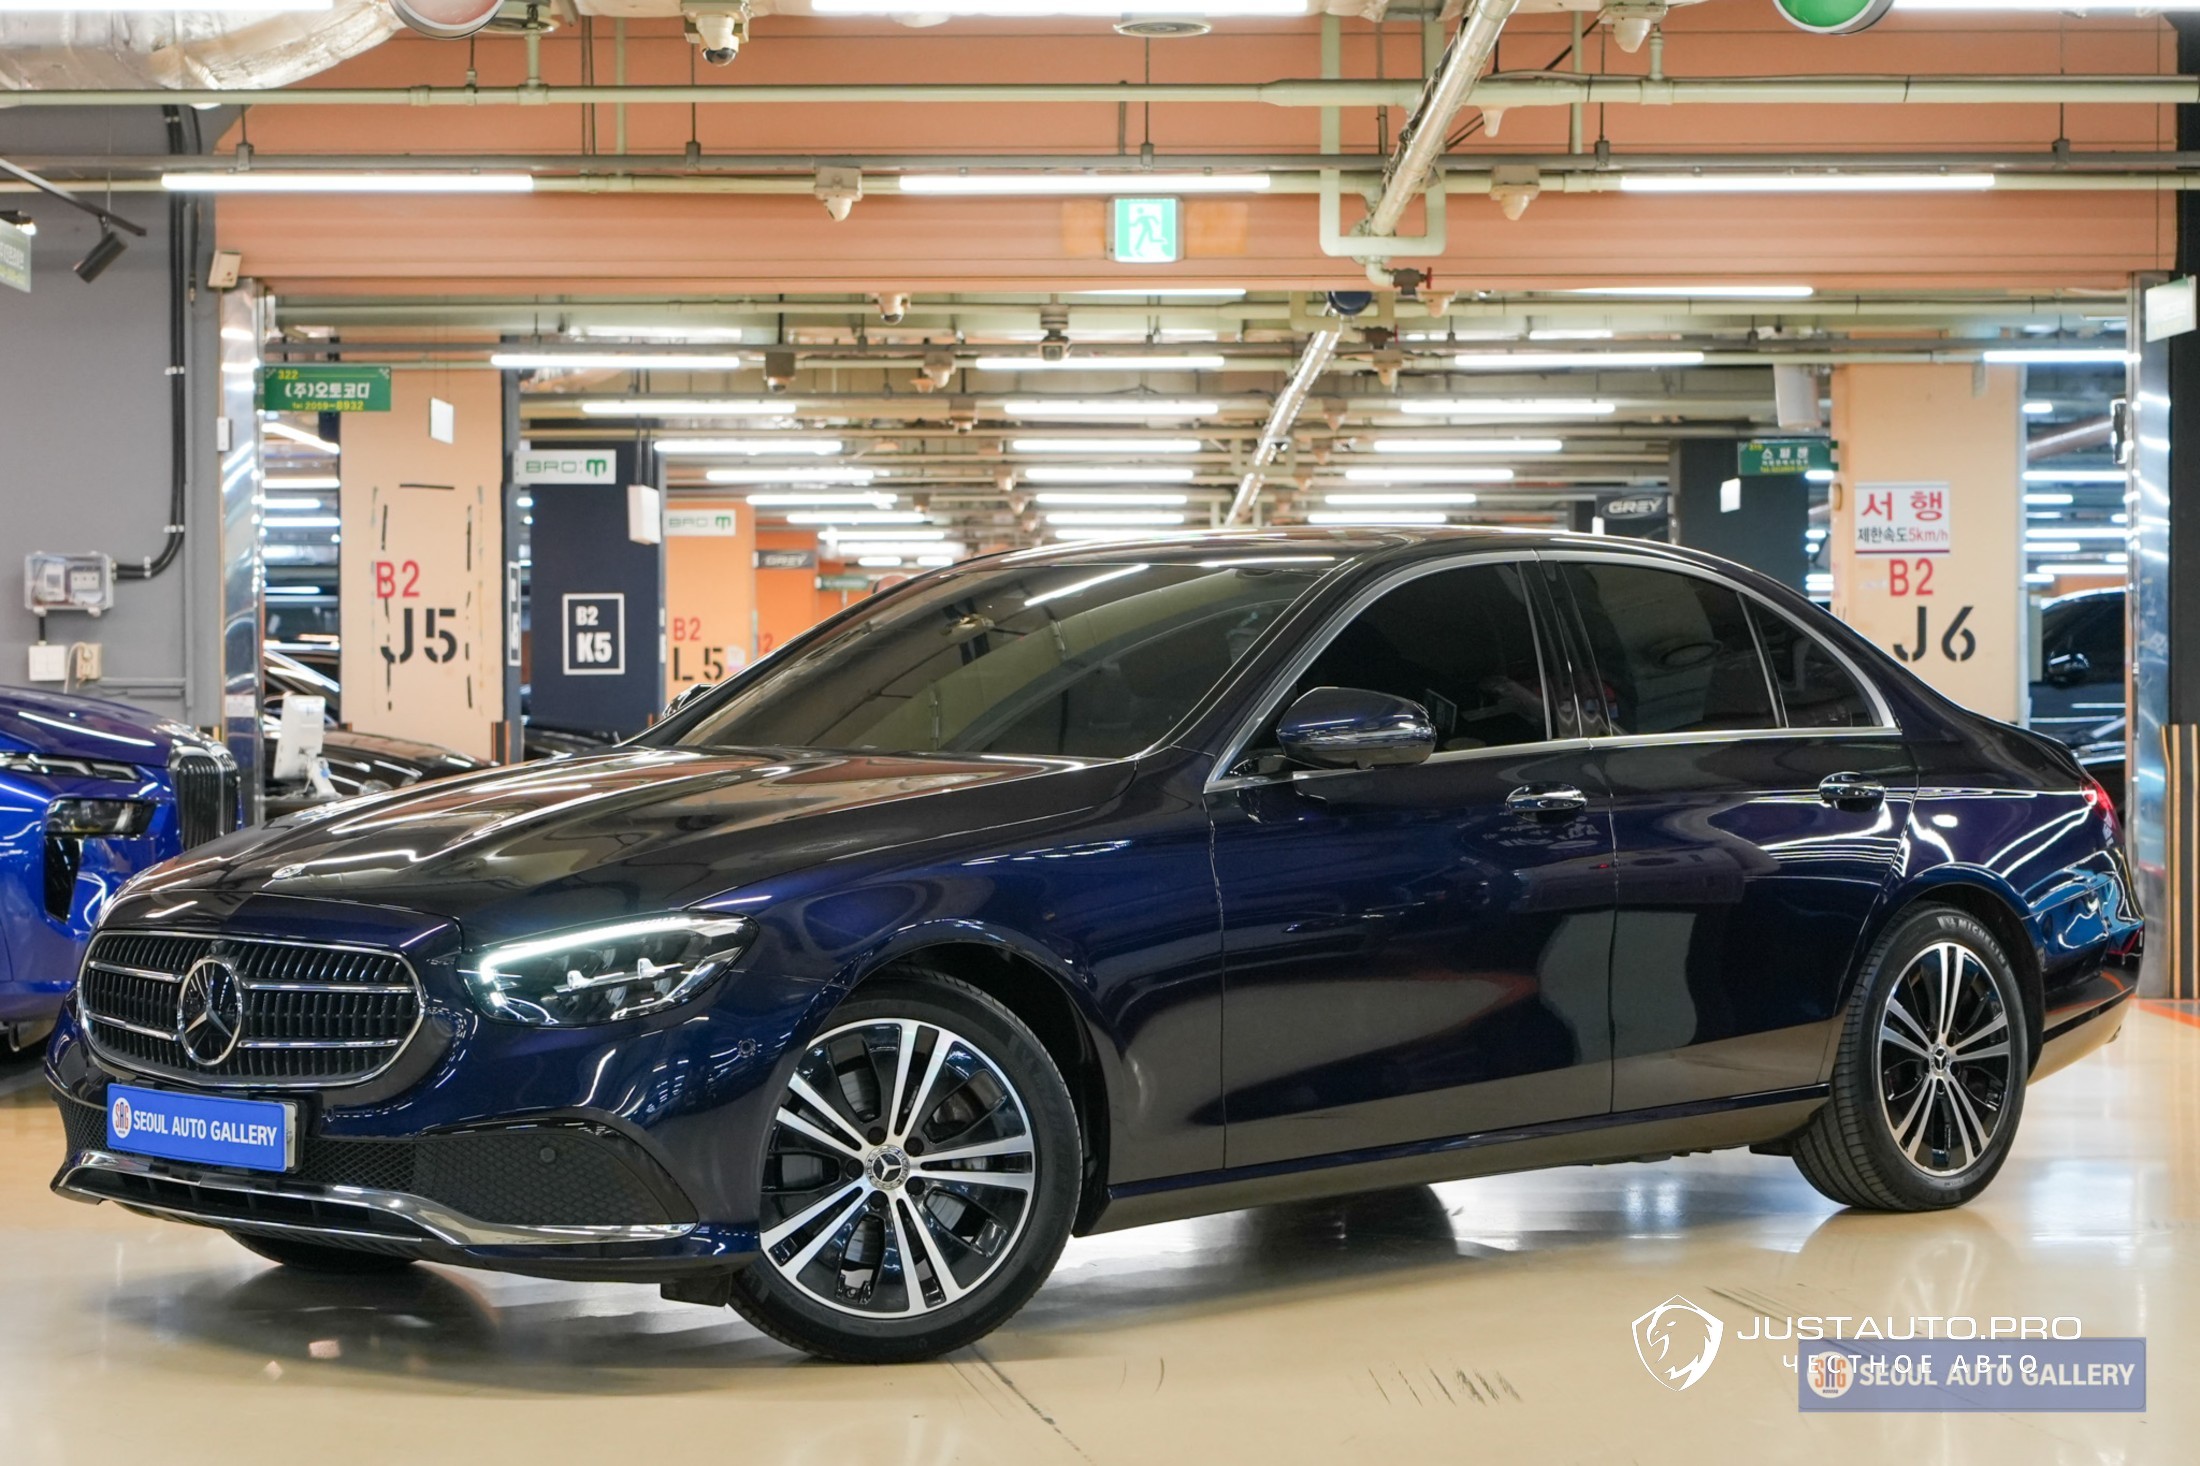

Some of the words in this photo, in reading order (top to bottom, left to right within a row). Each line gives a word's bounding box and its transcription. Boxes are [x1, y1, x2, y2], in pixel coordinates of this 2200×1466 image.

[1608, 500, 1664, 514] GREY
[376, 560, 420, 598] B2
[1889, 558, 1934, 597] B2
[575, 605, 599, 627] B2
[673, 617, 701, 641] B2
[1892, 605, 1976, 662] J6
[380, 608, 457, 664] J5
[576, 632, 613, 663] K5
[1957, 918, 2007, 964] MICHELIN
[133, 1110, 168, 1135] SEOUL
[171, 1116, 207, 1139] AUTO
[210, 1120, 278, 1147] GALLERY
